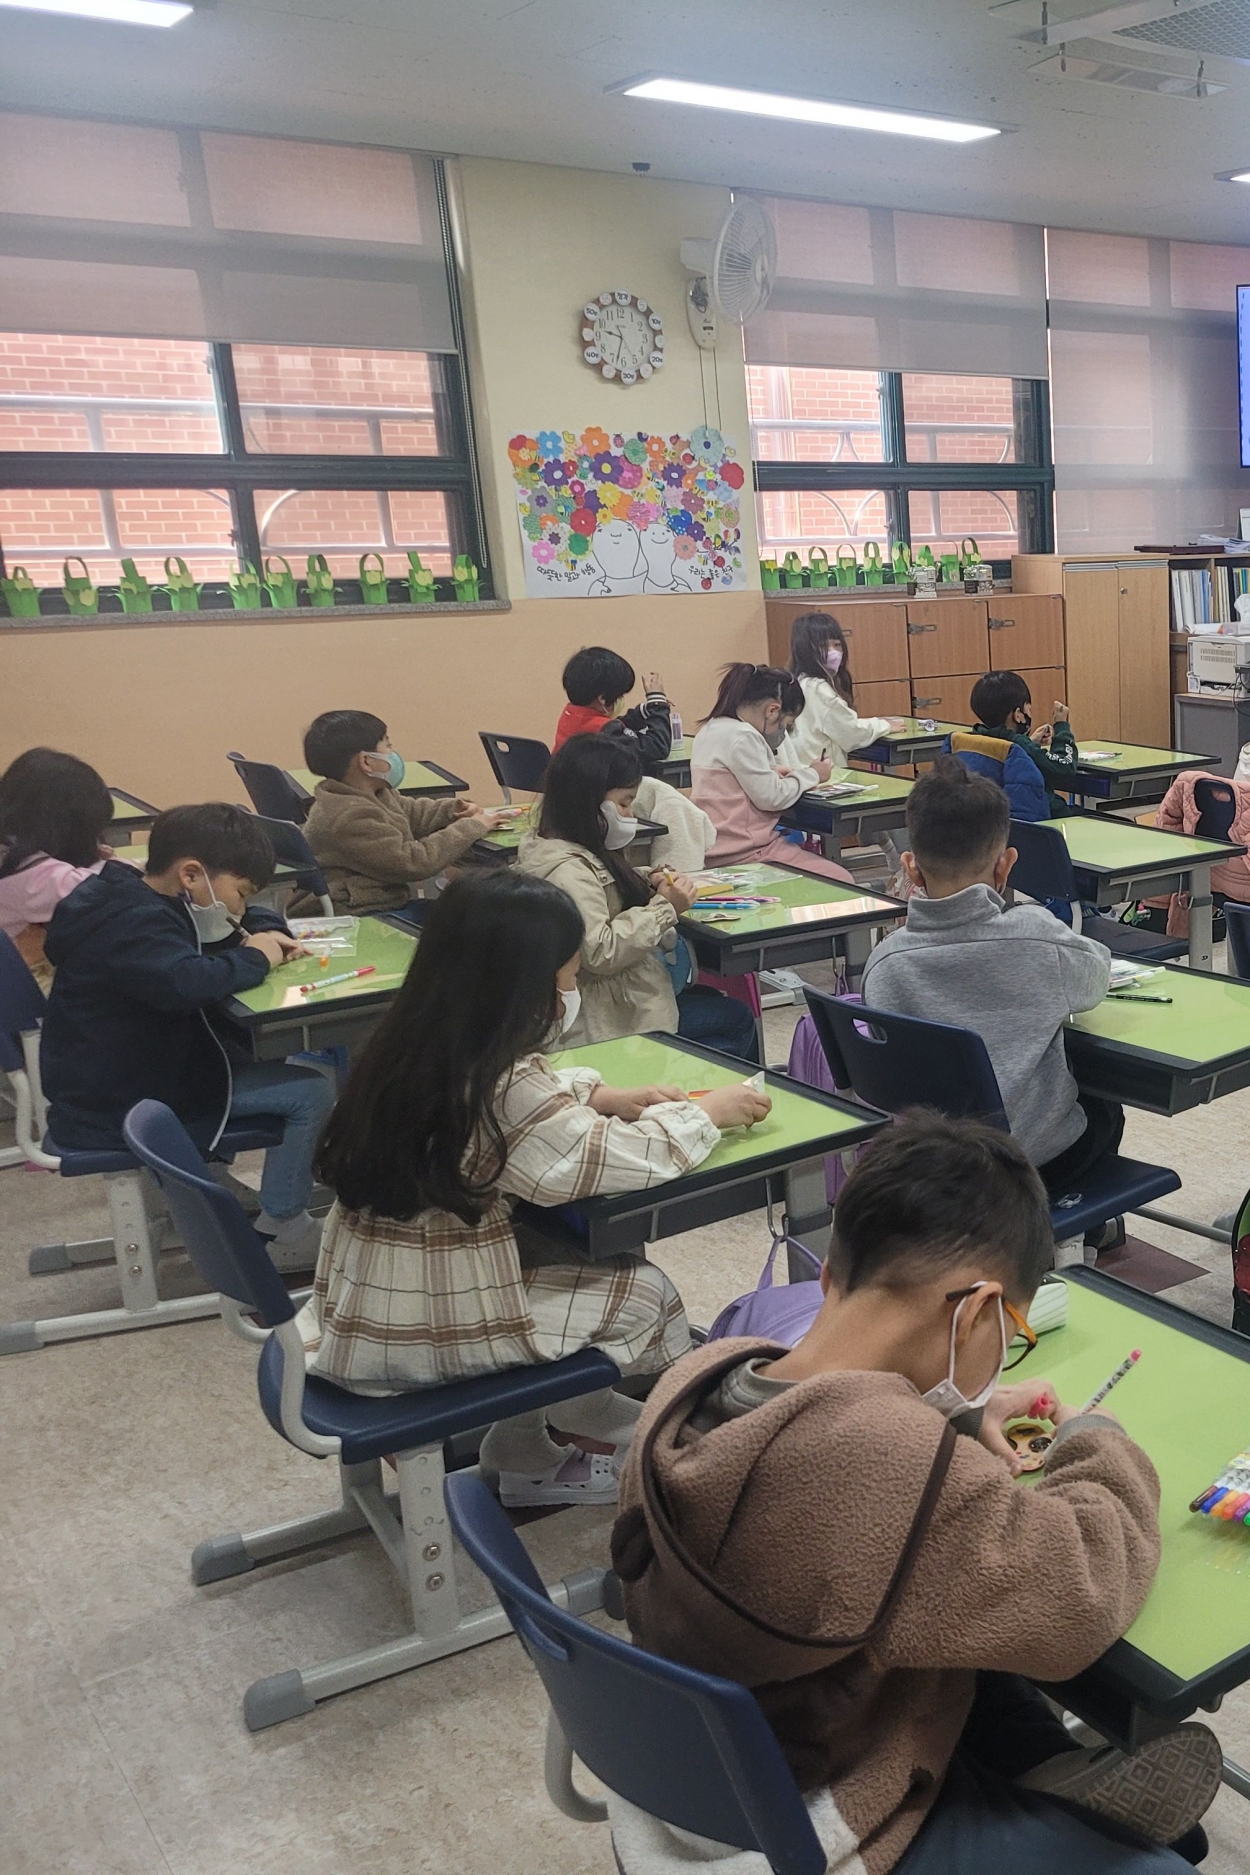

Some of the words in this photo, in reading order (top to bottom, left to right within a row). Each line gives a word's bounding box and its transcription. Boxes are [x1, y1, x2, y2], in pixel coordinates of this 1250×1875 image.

[606, 310, 614, 321] 11
[616, 308, 625, 319] 12
[599, 319, 606, 329] 10
[638, 322, 643, 331] 2
[595, 331, 601, 341] 9
[642, 333, 648, 344] 3
[600, 343, 606, 353] 8
[638, 345, 644, 356] 4
[609, 352, 615, 363] 7
[620, 357, 627, 367] 6
[632, 354, 638, 364] 5
[688, 565, 706, 579] 우리는
